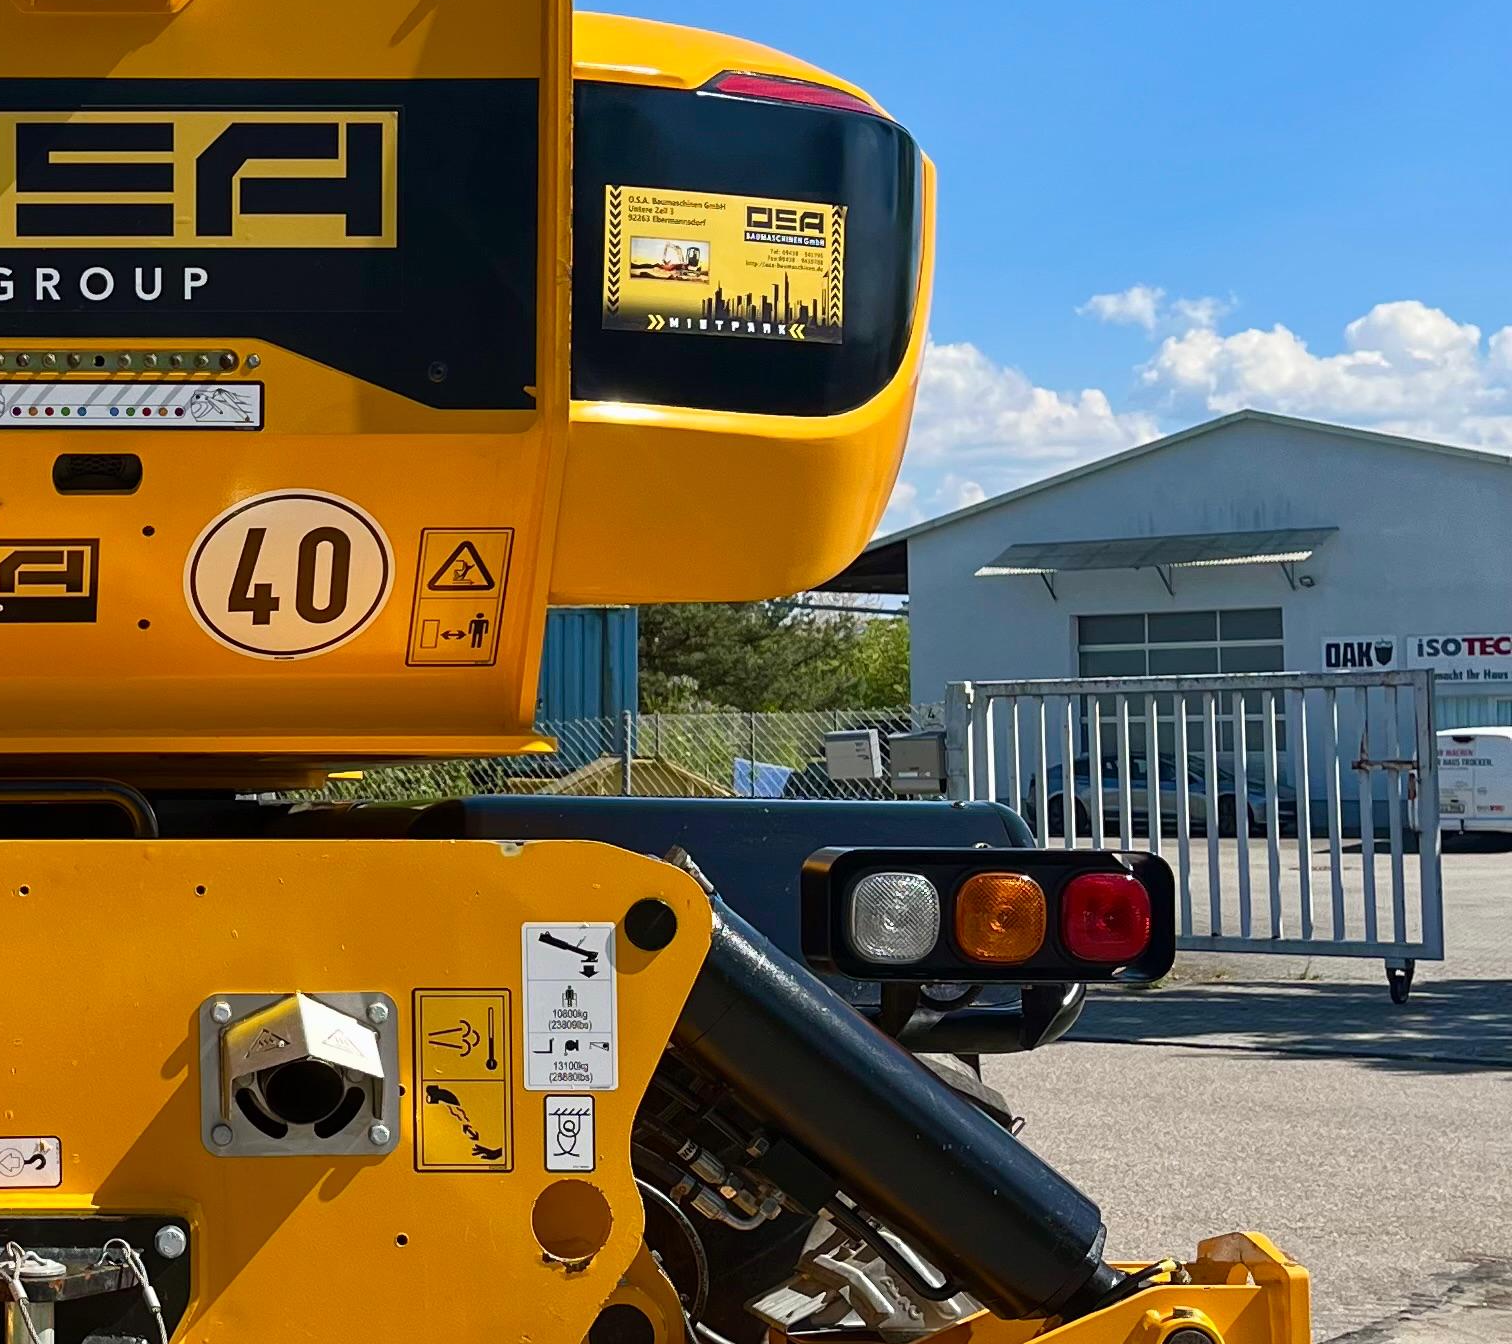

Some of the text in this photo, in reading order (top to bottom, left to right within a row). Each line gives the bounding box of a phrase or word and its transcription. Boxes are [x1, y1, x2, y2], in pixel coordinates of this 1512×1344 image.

[746, 205, 825, 234] OSA
[746, 232, 825, 247] BAUMASCHINEN GmbH
[227, 525, 353, 626] 40
[1325, 641, 1374, 668] OAK
[1466, 667, 1480, 680] Ihr
[1483, 667, 1509, 680] Haus
[552, 1008, 588, 1020] 10800kg
[548, 1019, 592, 1031] (23809lbs)
[553, 1061, 589, 1073] 13100kg
